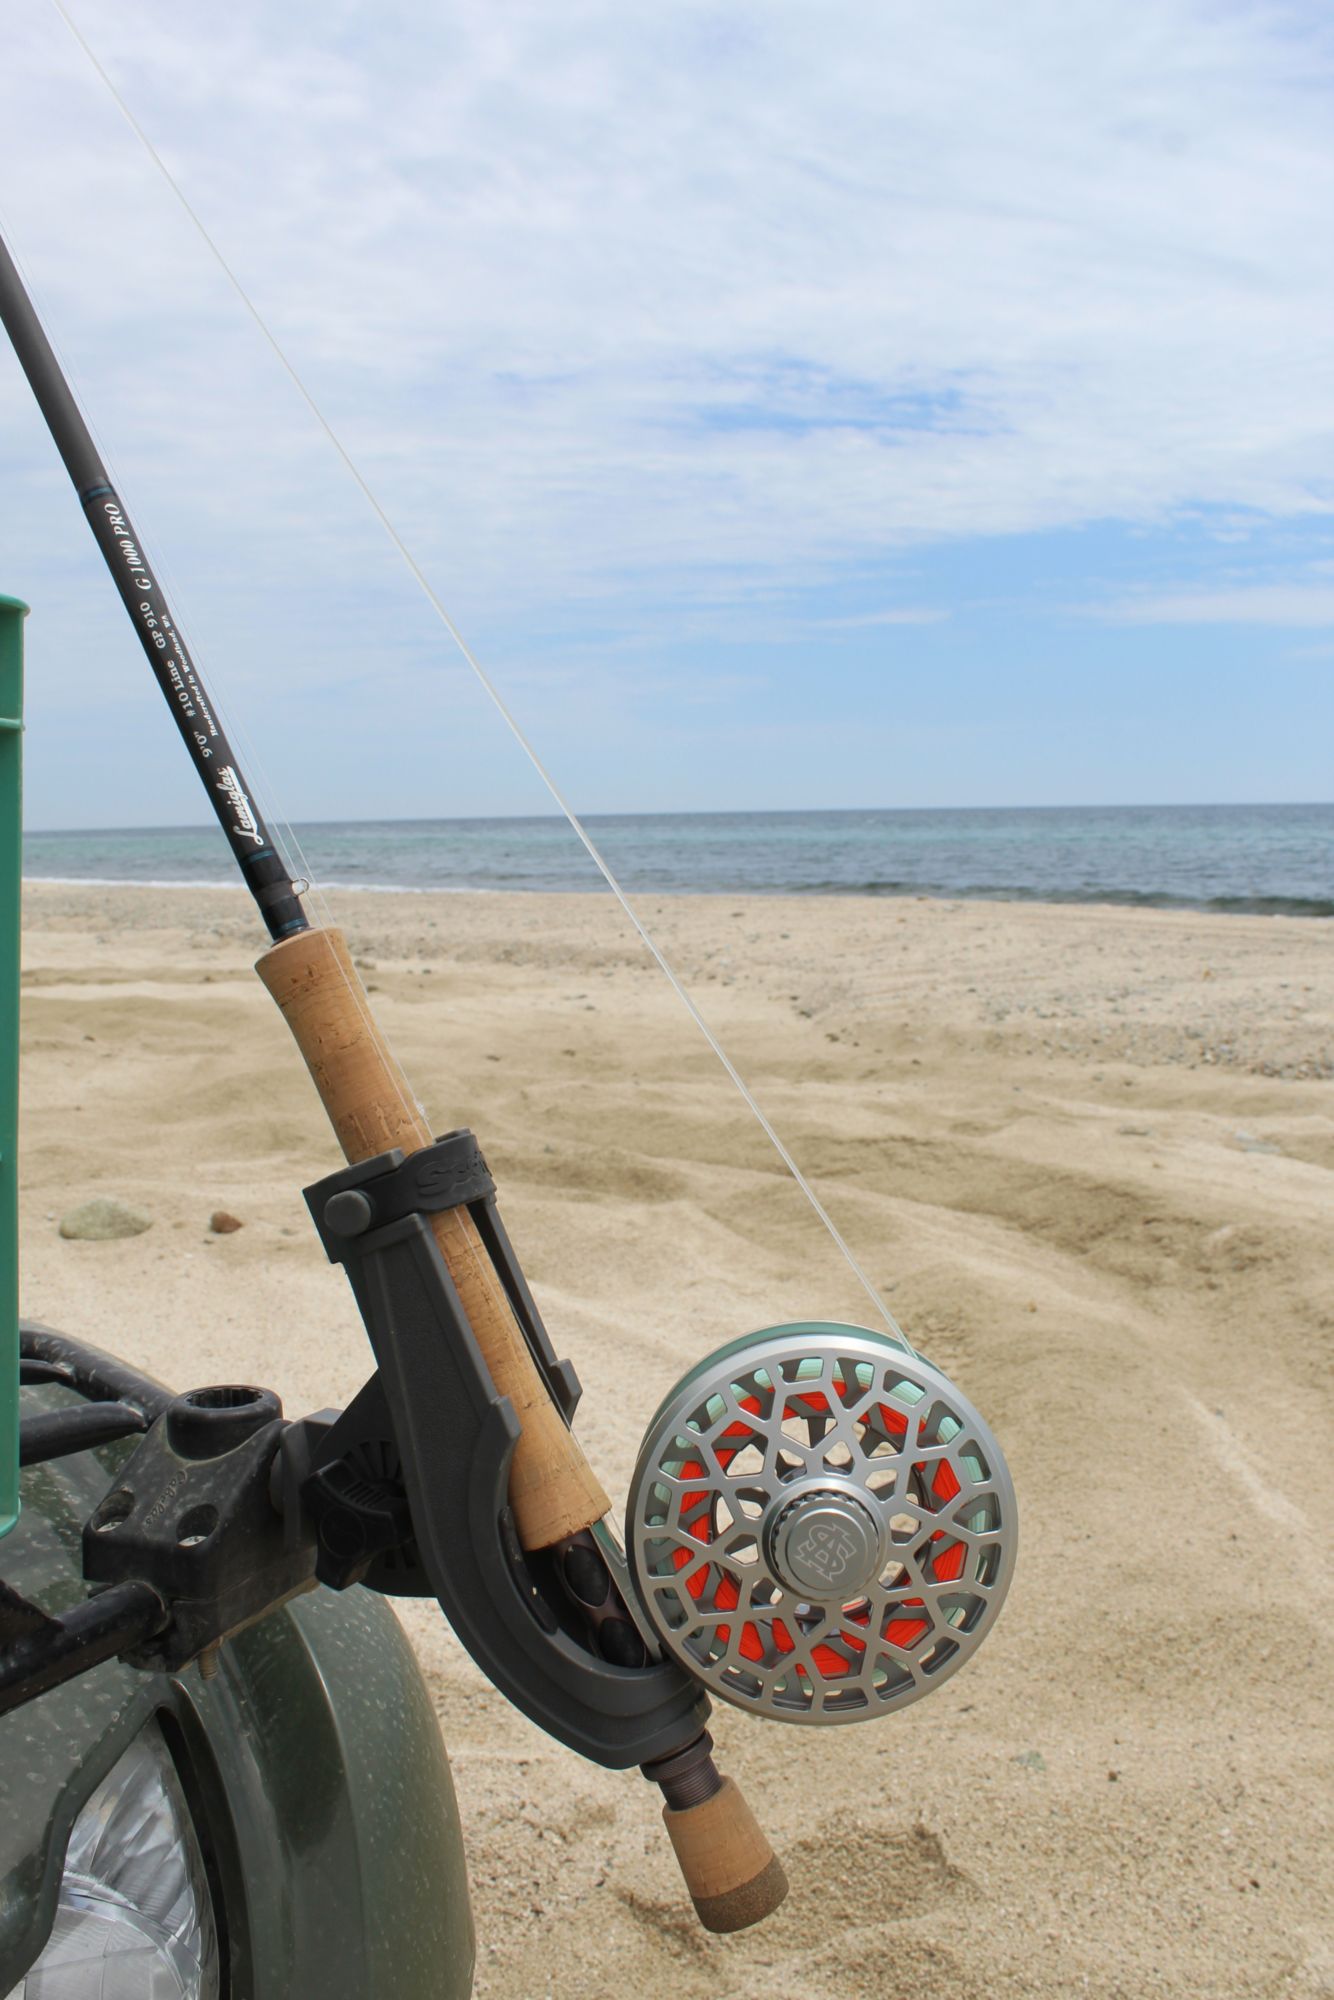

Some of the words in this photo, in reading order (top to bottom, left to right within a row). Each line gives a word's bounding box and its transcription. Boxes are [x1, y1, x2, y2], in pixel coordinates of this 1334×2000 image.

[104, 502, 130, 536] PRO
[119, 539, 146, 573] 1000
[134, 577, 152, 590] G
[139, 601, 158, 628] 910
[160, 614, 171, 628] WA
[151, 630, 166, 649] GP
[167, 629, 190, 673] Woodland,
[166, 659, 185, 691] Line
[178, 691, 196, 717] #10
[190, 685, 219, 737] Handcrafted
[216, 764, 265, 846] Lamiglas
